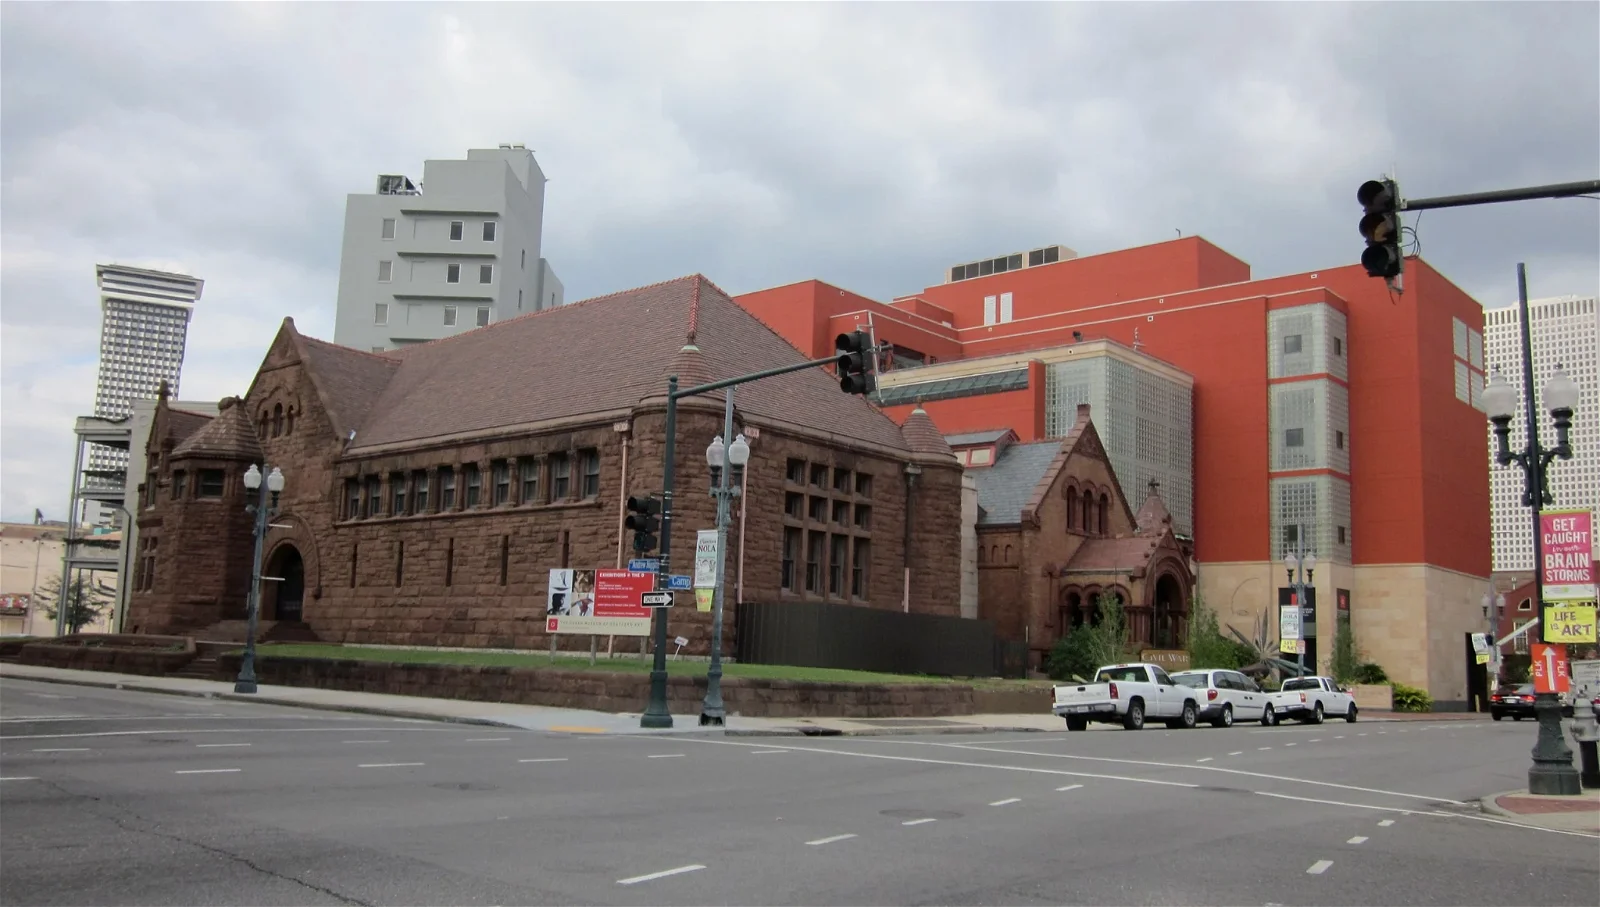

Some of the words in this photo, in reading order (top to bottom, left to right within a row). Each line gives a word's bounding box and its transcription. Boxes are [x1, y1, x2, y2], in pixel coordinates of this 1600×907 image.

[1552, 517, 1576, 531] GET
[1544, 532, 1588, 545] CAUGHT
[698, 544, 716, 553] NOLA
[1545, 553, 1590, 569] BRAIN
[672, 576, 690, 588] Camp
[1546, 569, 1590, 582] STORMS
[1554, 611, 1577, 621] LIFE
[1561, 624, 1592, 636] ART
[1141, 653, 1166, 662] CIVIL
[1168, 653, 1188, 662] WAR
[1535, 661, 1543, 677] PLK
[1557, 661, 1566, 677] PLK
